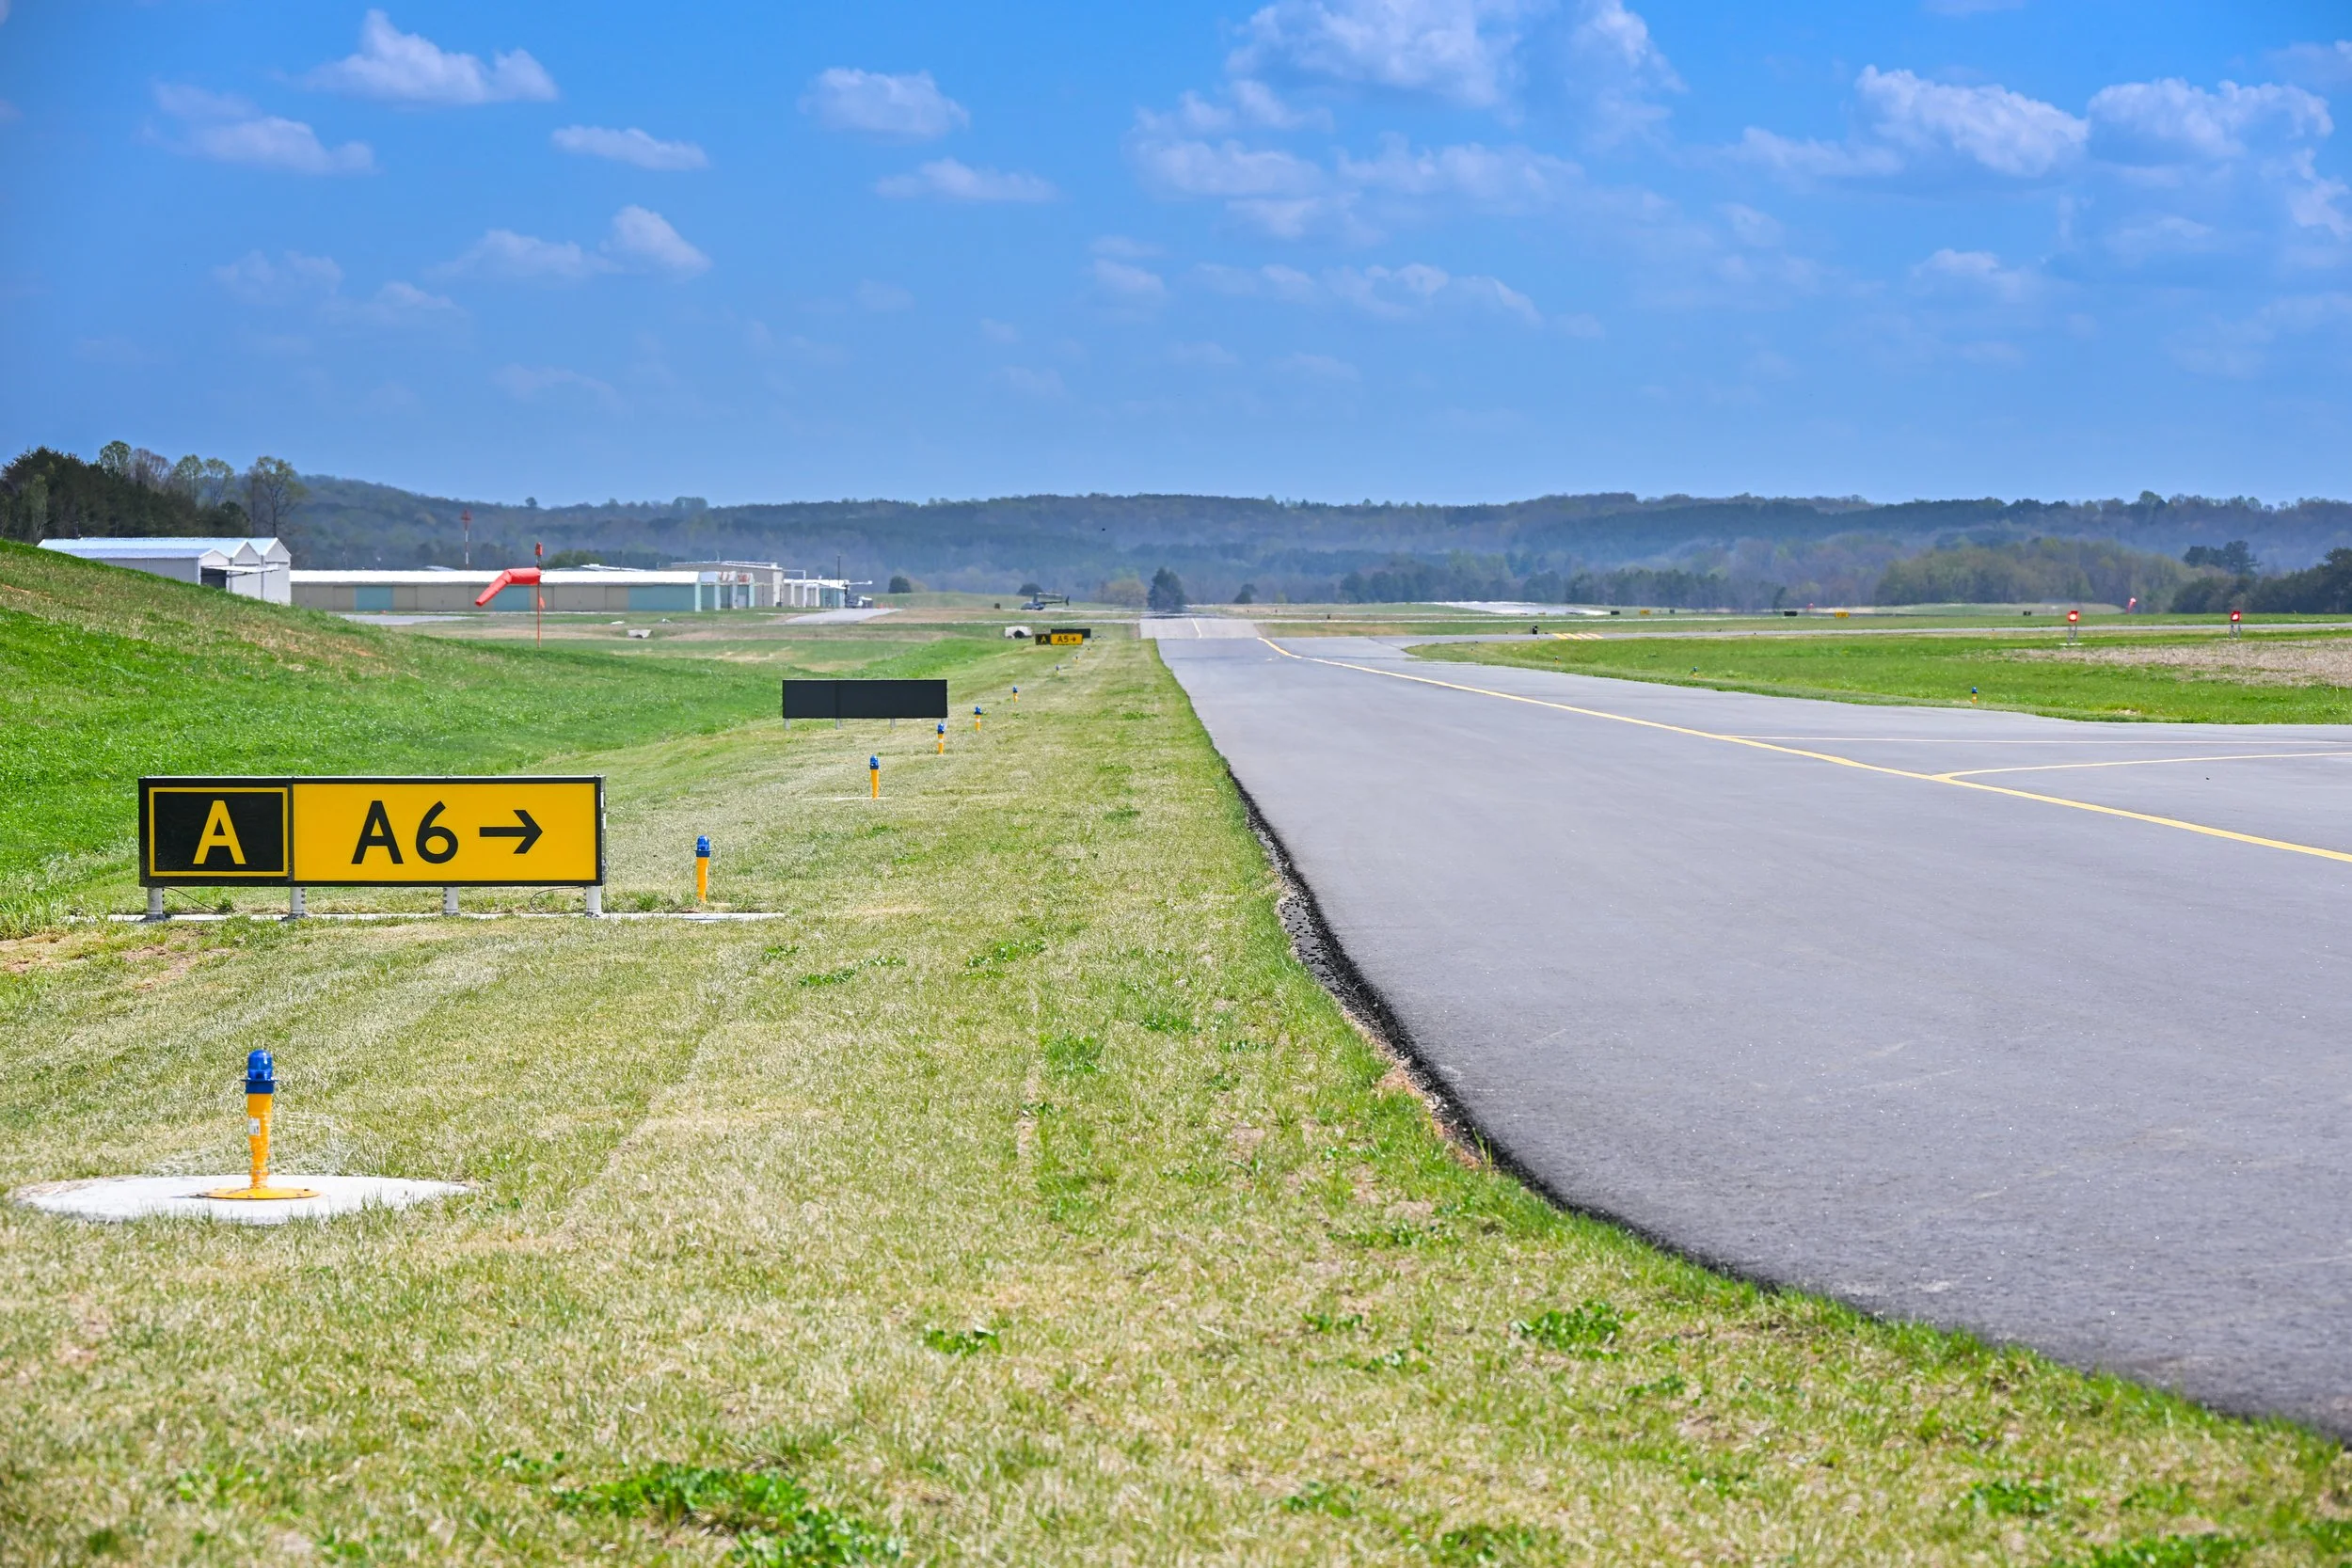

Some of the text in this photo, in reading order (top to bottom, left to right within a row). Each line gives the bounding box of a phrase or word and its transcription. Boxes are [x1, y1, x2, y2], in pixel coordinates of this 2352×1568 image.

[1041, 635, 1069, 643] A A5
[192, 800, 459, 864] A A6
